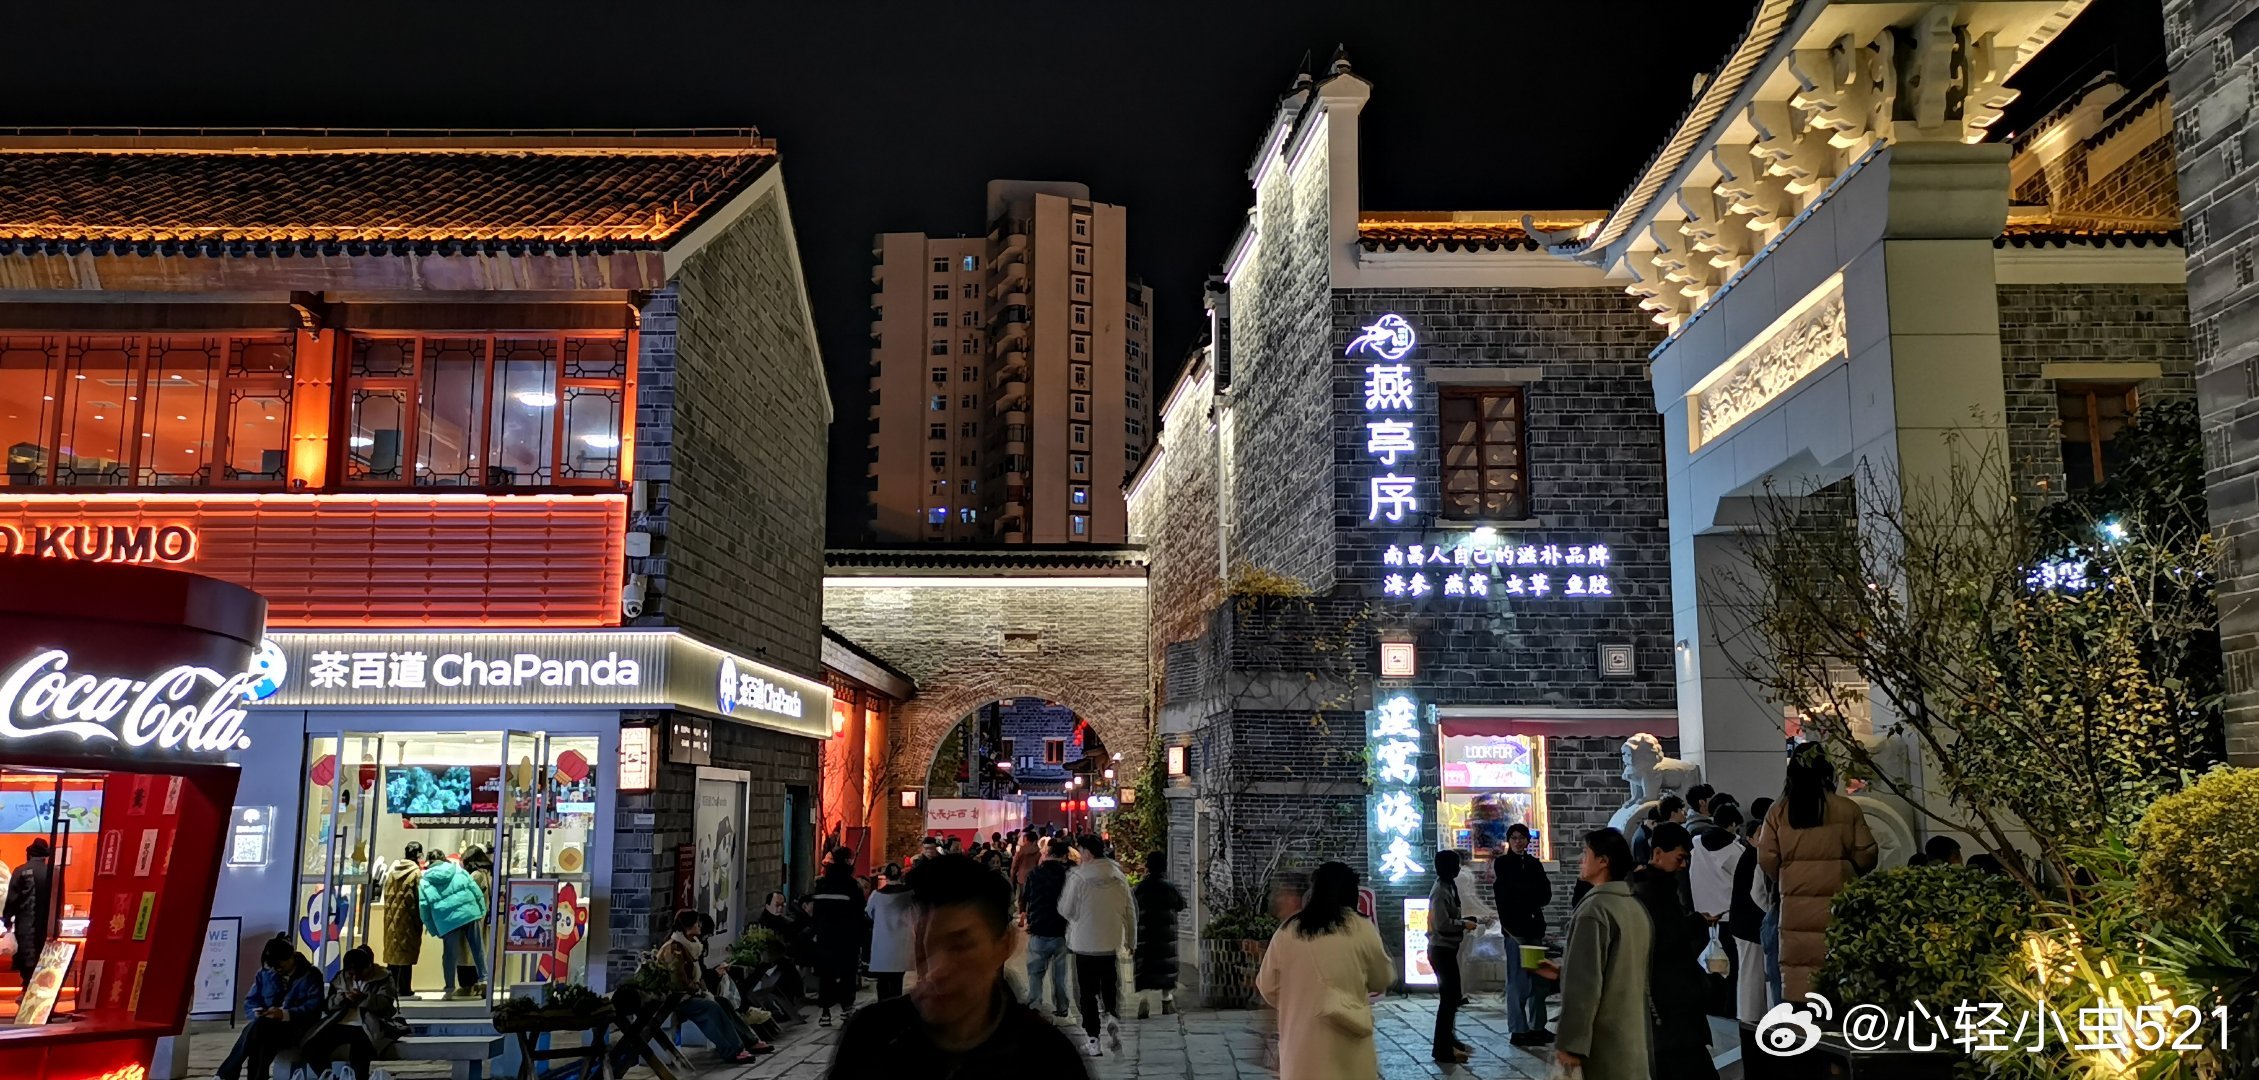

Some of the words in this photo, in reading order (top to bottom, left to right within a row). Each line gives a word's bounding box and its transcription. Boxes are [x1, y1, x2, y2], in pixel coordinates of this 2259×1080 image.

[1364, 362, 1417, 522] 燕亭序
[35, 525, 194, 562] KUMO
[1382, 545, 1611, 568] 南昌人自己的滋补品牌
[1382, 573, 1430, 597] 海参
[1443, 573, 1489, 597] 燕窝
[1505, 573, 1551, 597] 虫草
[1563, 573, 1613, 597] 鱼胶
[310, 651, 427, 689] 茶百道
[433, 652, 640, 687] ChaPanda
[1464, 745, 1491, 758] LOOK
[1493, 745, 1513, 758] FOR
[209, 930, 228, 941] WE
